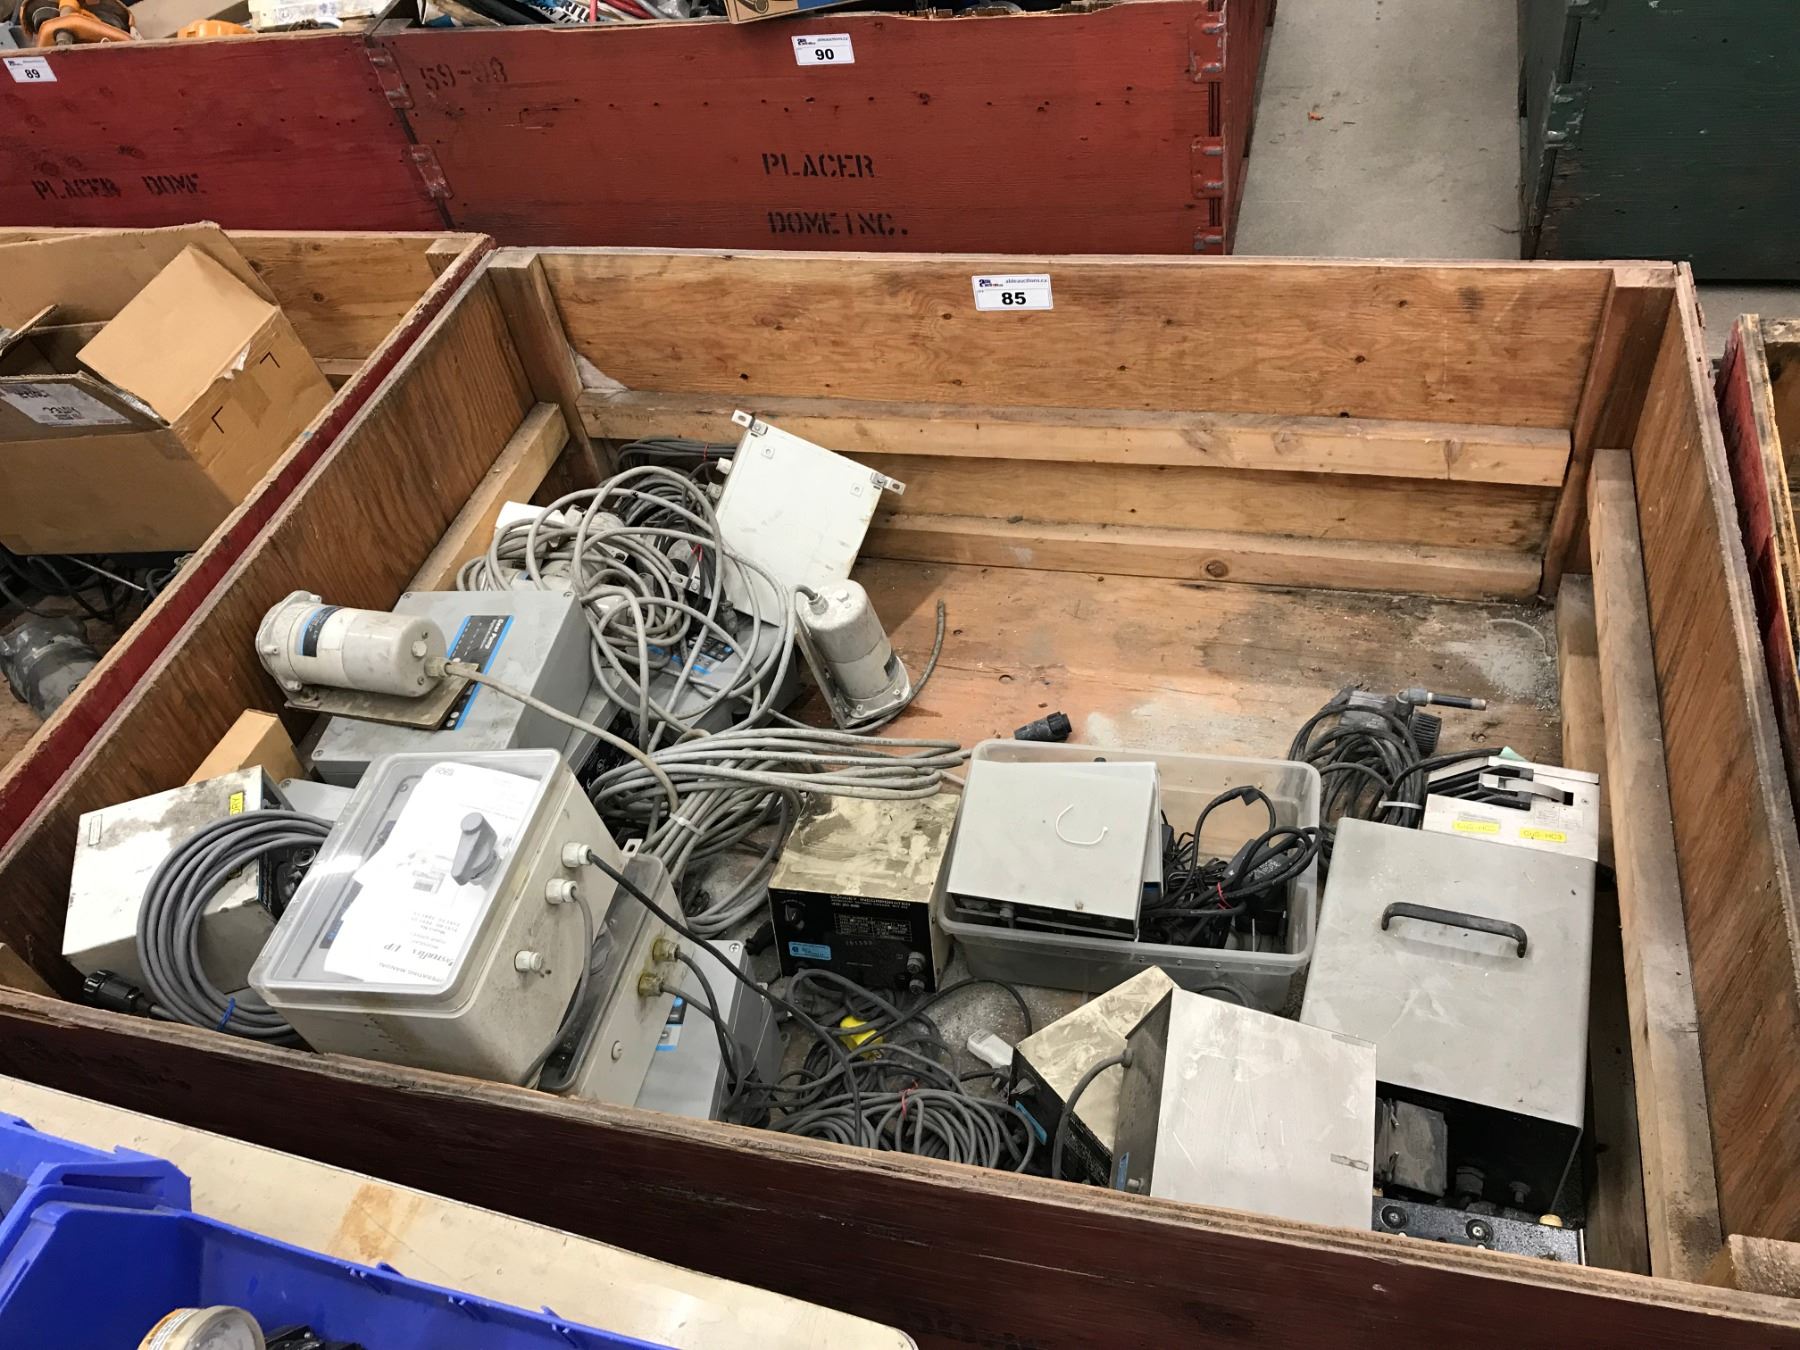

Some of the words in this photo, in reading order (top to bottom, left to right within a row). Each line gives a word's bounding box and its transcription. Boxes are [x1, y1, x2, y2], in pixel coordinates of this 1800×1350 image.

[815, 48, 834, 60] 90
[24, 68, 41, 79] 89
[762, 153, 875, 177] PLACER
[767, 211, 841, 235] DOME
[1001, 291, 1027, 305] 85
